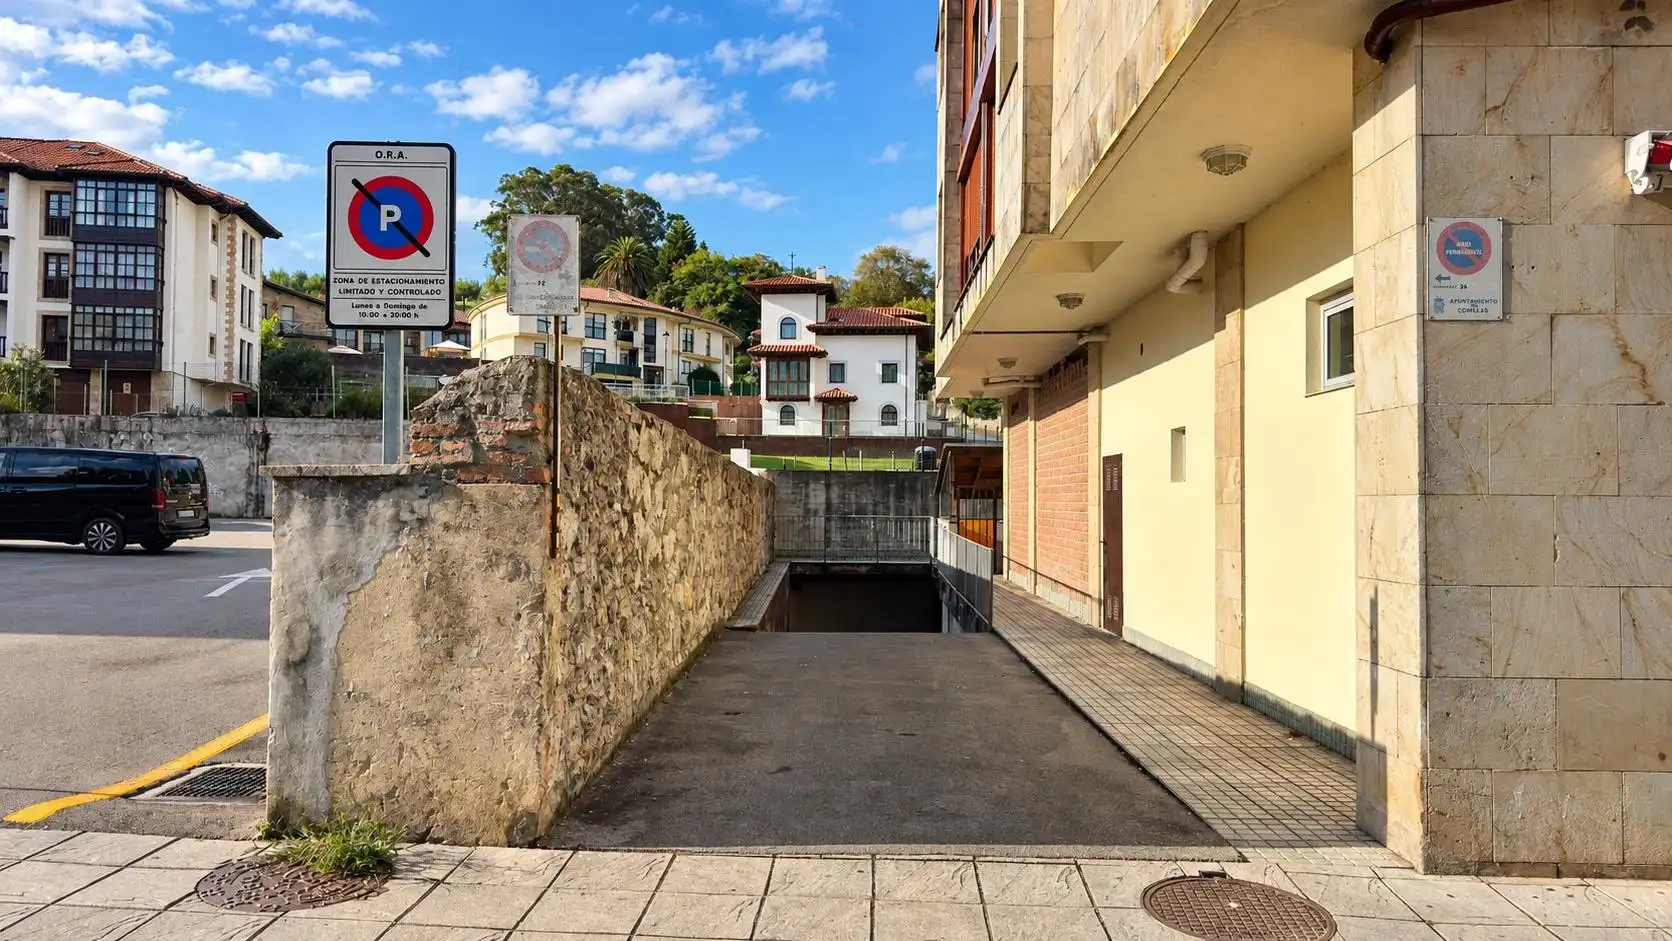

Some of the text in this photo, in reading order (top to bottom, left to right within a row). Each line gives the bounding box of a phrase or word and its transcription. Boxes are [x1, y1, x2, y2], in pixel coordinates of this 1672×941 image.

[375, 150, 408, 160] O.R.A.
[380, 204, 402, 231] P
[358, 277, 368, 285] DE
[387, 288, 442, 296] CONTROLADO
[383, 302, 416, 310] Domingo
